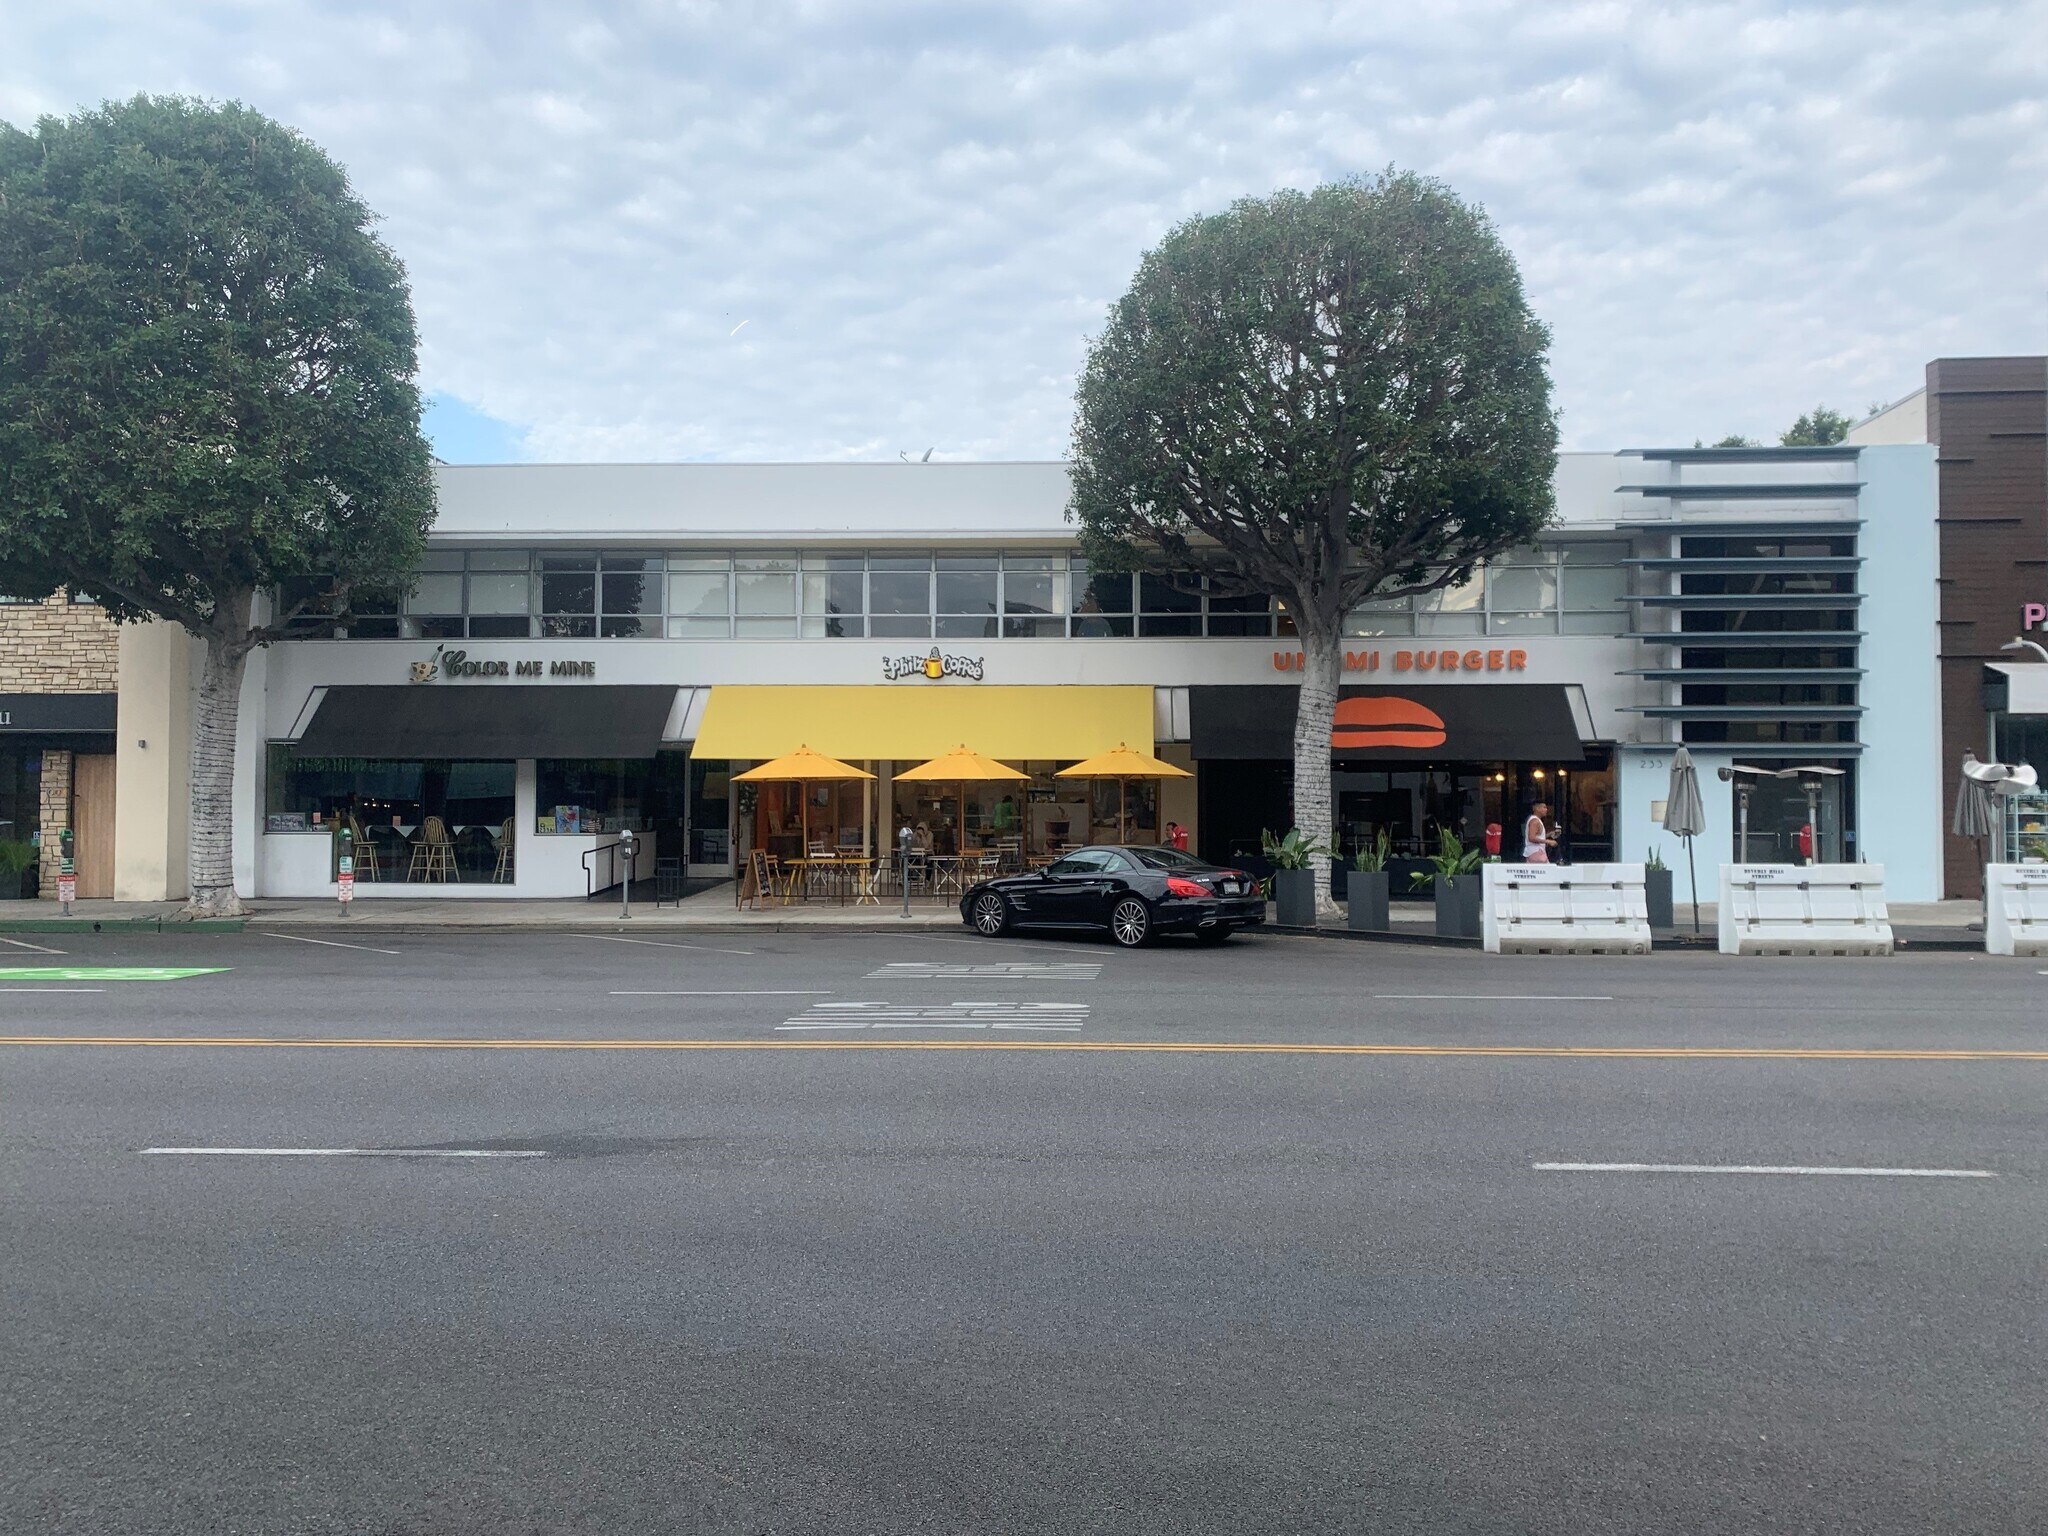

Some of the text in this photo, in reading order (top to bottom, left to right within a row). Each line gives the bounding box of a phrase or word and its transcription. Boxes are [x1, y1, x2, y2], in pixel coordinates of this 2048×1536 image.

[515, 660, 543, 676] ME
[550, 660, 596, 676] MINE
[882, 654, 984, 681] Philz Coffee
[1273, 649, 1528, 671] UMI BURGER
[1640, 759, 1664, 769] 233
